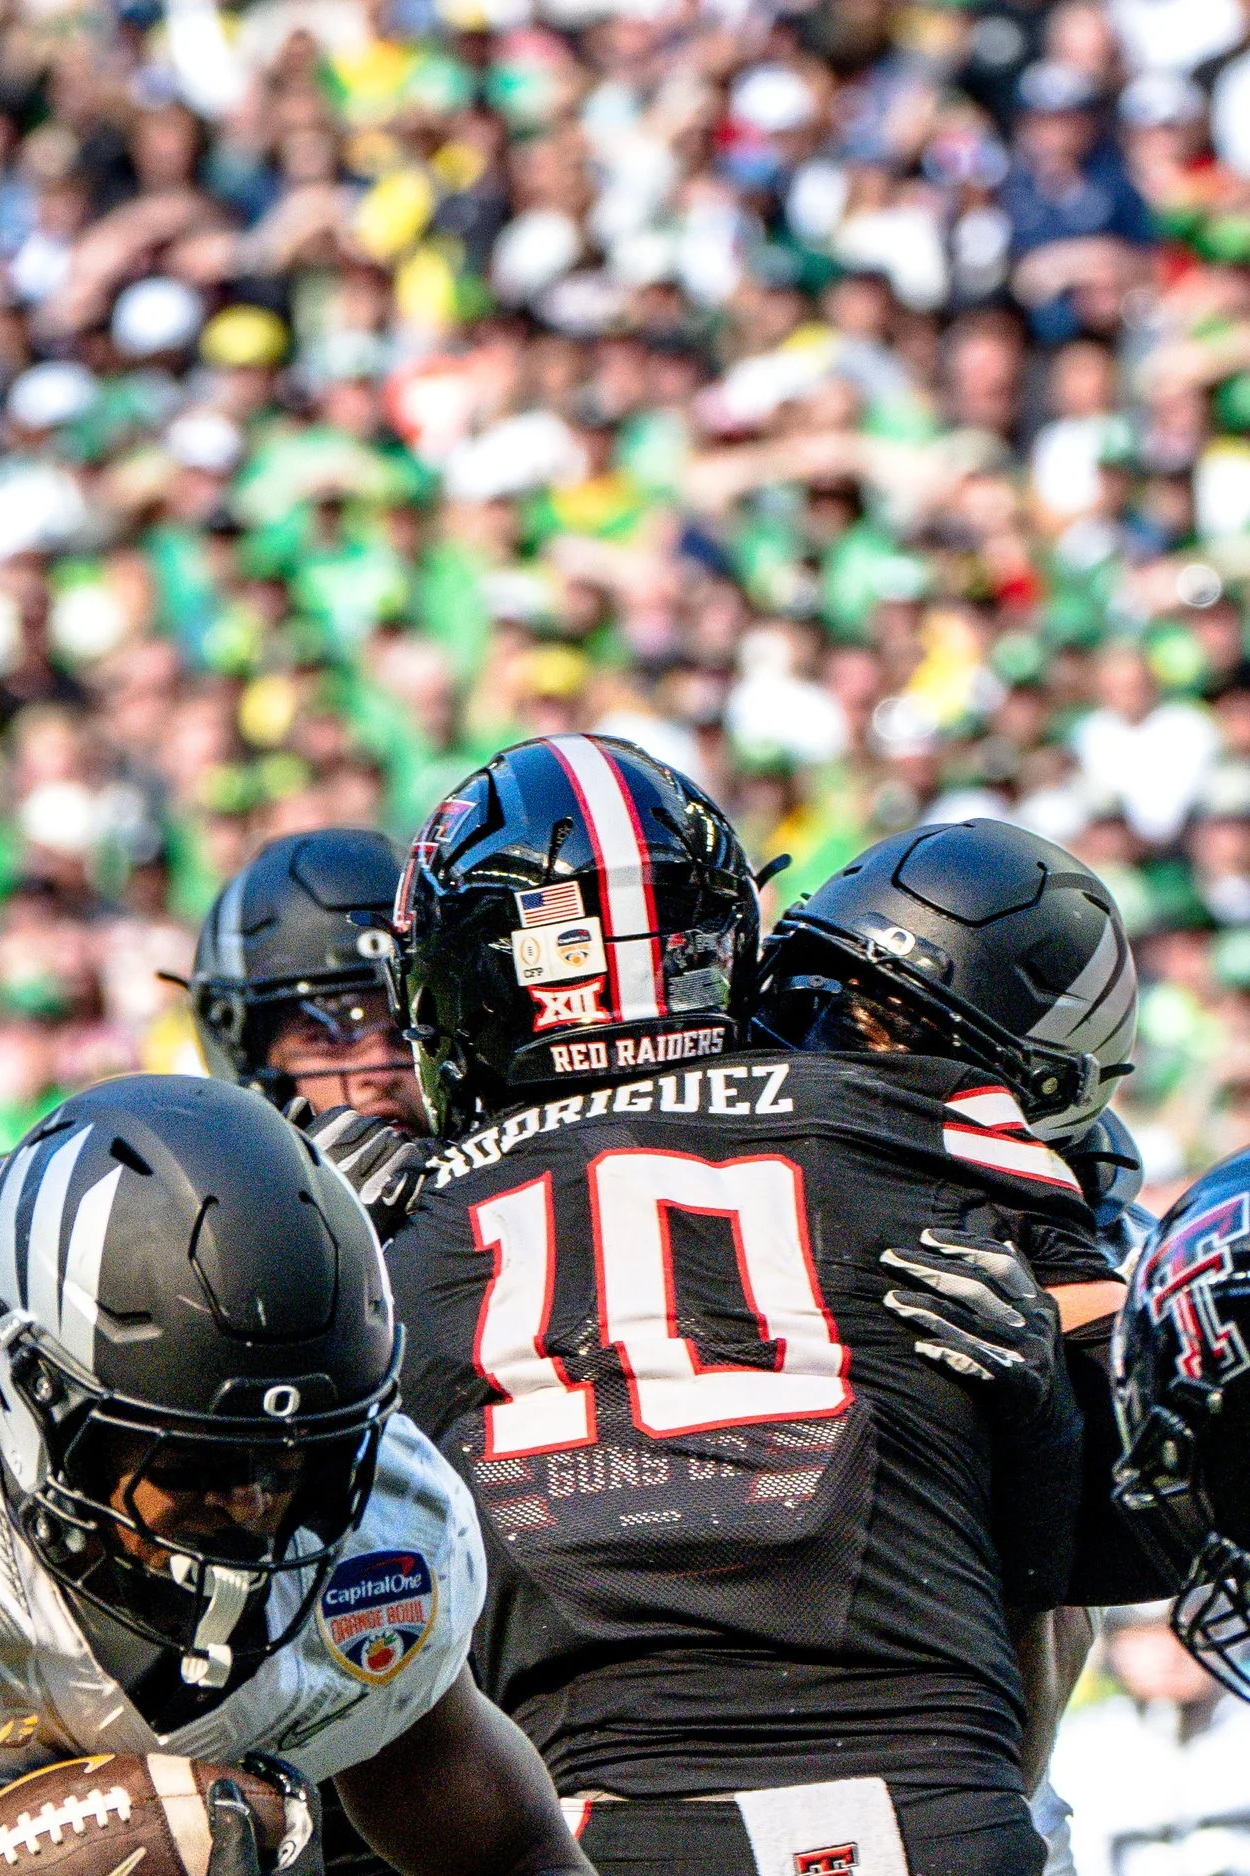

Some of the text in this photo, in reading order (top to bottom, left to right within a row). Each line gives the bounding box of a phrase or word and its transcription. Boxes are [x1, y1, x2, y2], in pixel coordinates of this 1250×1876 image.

[550, 1026, 727, 1074] RED RAIDERS
[468, 1146, 856, 1461] 10
[263, 1384, 301, 1418] O
[330, 1597, 429, 1646] ORANGE BOWL
